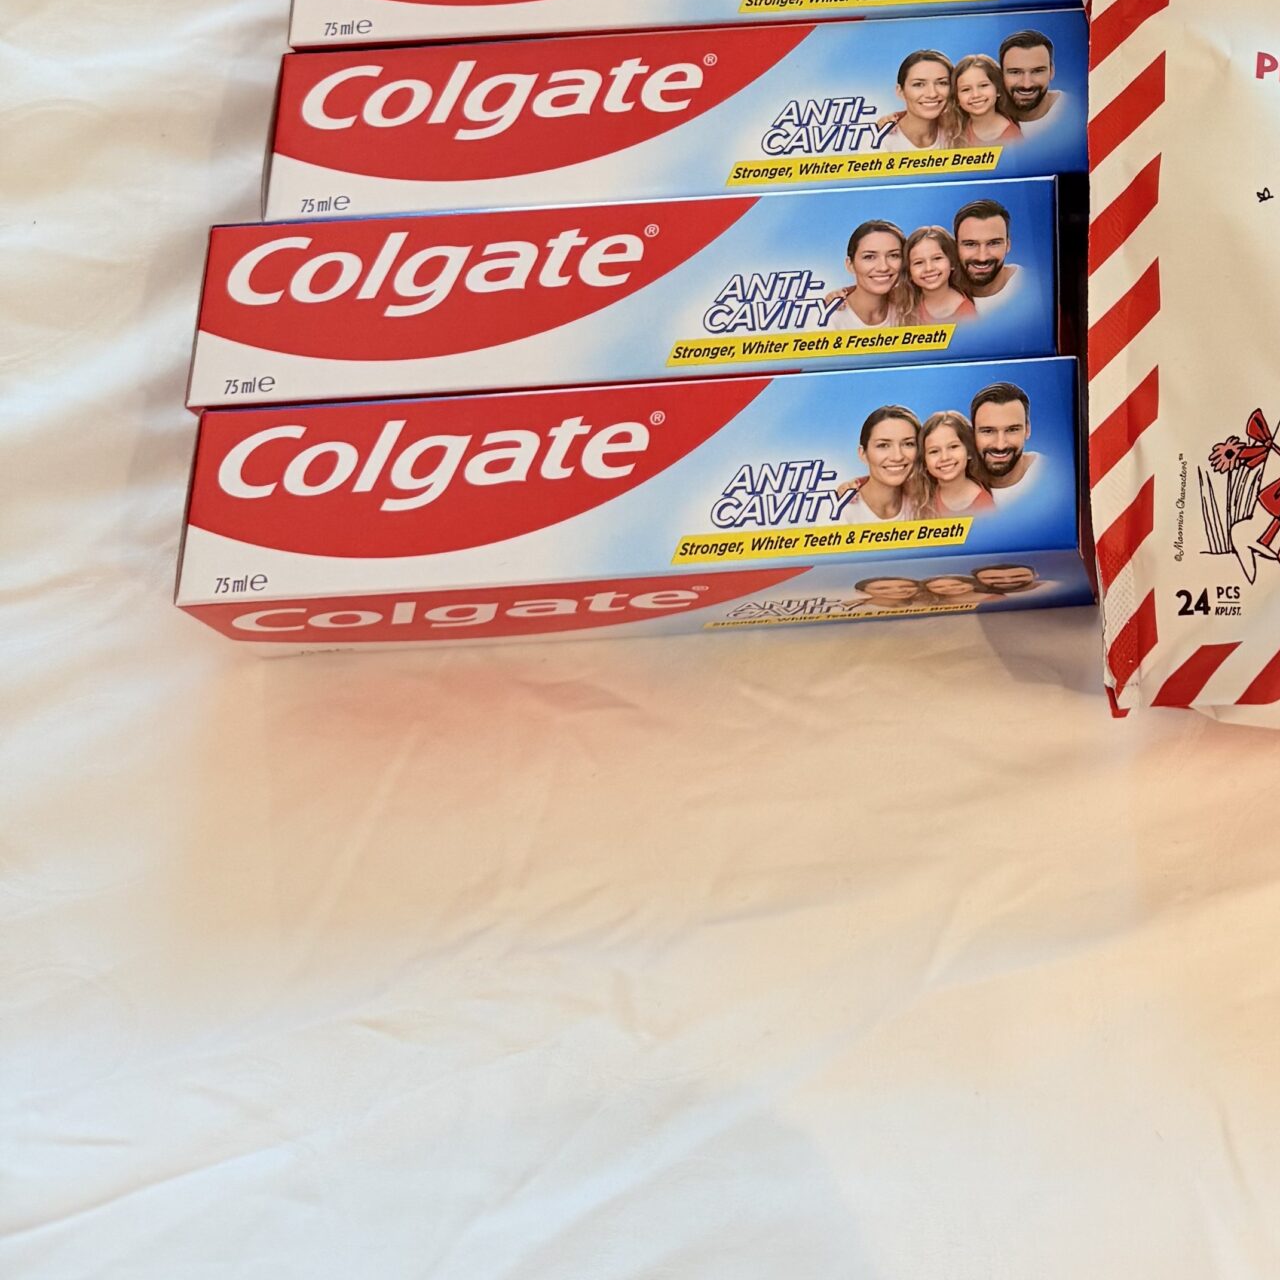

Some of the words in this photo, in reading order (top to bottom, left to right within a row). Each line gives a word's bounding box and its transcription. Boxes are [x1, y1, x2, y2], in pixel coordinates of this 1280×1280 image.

[324, 22, 338, 36] 75
[772, 97, 877, 127] ANTI-
[761, 121, 896, 156] CAVITY
[732, 166, 793, 179] Stronger,
[799, 161, 844, 175] Whiter
[847, 158, 883, 172] Teeth
[885, 157, 895, 170] &
[898, 154, 949, 169] Fresher
[951, 151, 995, 166] Breath
[300, 199, 315, 213] 75
[715, 270, 824, 302] ANTI-
[703, 297, 842, 333] CAVITY
[672, 345, 735, 359] Stronger,
[742, 340, 789, 355] Whiter
[792, 336, 829, 352] Teeth
[832, 335, 842, 349] &
[845, 333, 899, 348] Fresher
[901, 329, 947, 345] Breath
[224, 380, 239, 395] 75
[722, 459, 837, 494] ANTI-
[711, 487, 859, 528] CAVITY
[678, 541, 744, 556] Stronger,
[751, 535, 800, 551] Whiter
[803, 531, 842, 548] Teeth
[845, 530, 855, 545] &
[858, 527, 915, 544] Fresher
[916, 523, 964, 540] Breath
[215, 577, 230, 594] 75
[1216, 586, 1240, 599] PCS
[1175, 587, 1211, 616] 24
